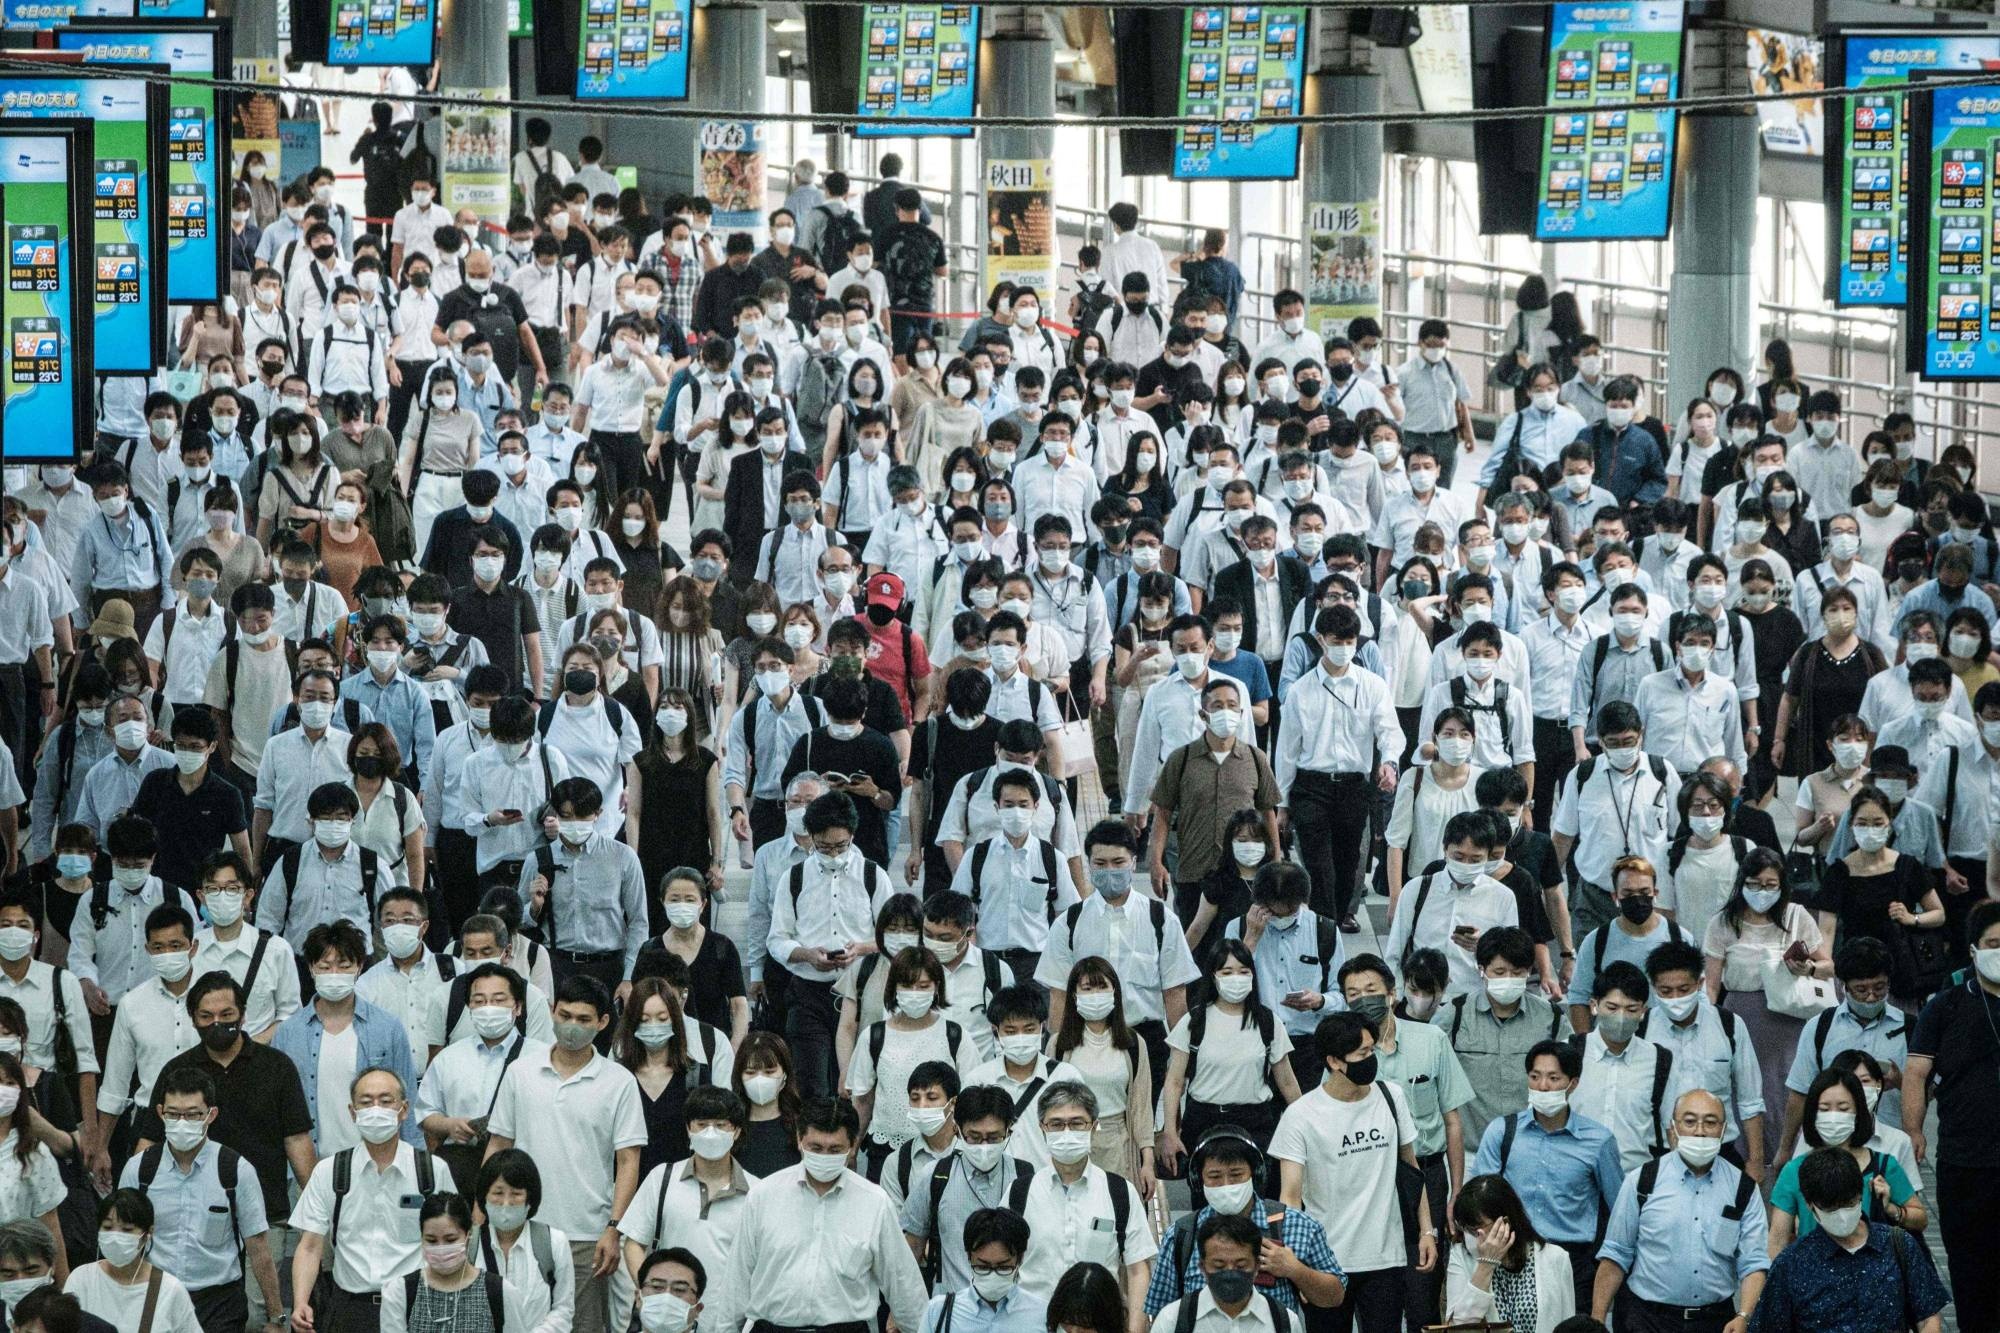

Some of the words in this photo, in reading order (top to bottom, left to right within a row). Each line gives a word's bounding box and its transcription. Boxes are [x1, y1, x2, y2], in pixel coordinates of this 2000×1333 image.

[84, 45, 150, 61] 今日の天気
[1868, 49, 1936, 64] 今日の天気
[4, 91, 79, 107] 今日の天気
[173, 108, 194, 117] 水戸
[705, 124, 742, 147] 青森
[187, 152, 204, 161] 23°C
[104, 161, 127, 172] 水戸
[991, 165, 1034, 188] 秋田
[117, 199, 136, 208] 31°C
[117, 210, 136, 219] 23°C
[1314, 207, 1359, 231] 山形
[1945, 216, 1978, 228] 八王子
[22, 227, 45, 239] 水戸
[187, 229, 205, 238] 23°C
[36, 268, 57, 279] 31°C
[36, 280, 58, 291] 23°C
[119, 282, 138, 292] 31°C
[119, 293, 138, 302] 23°C
[38, 360, 60, 371] 31°C
[38, 372, 60, 383] 23°C
[1342, 1128, 1385, 1148] A.P.C.
[1350, 1145, 1373, 1154] MADAME
